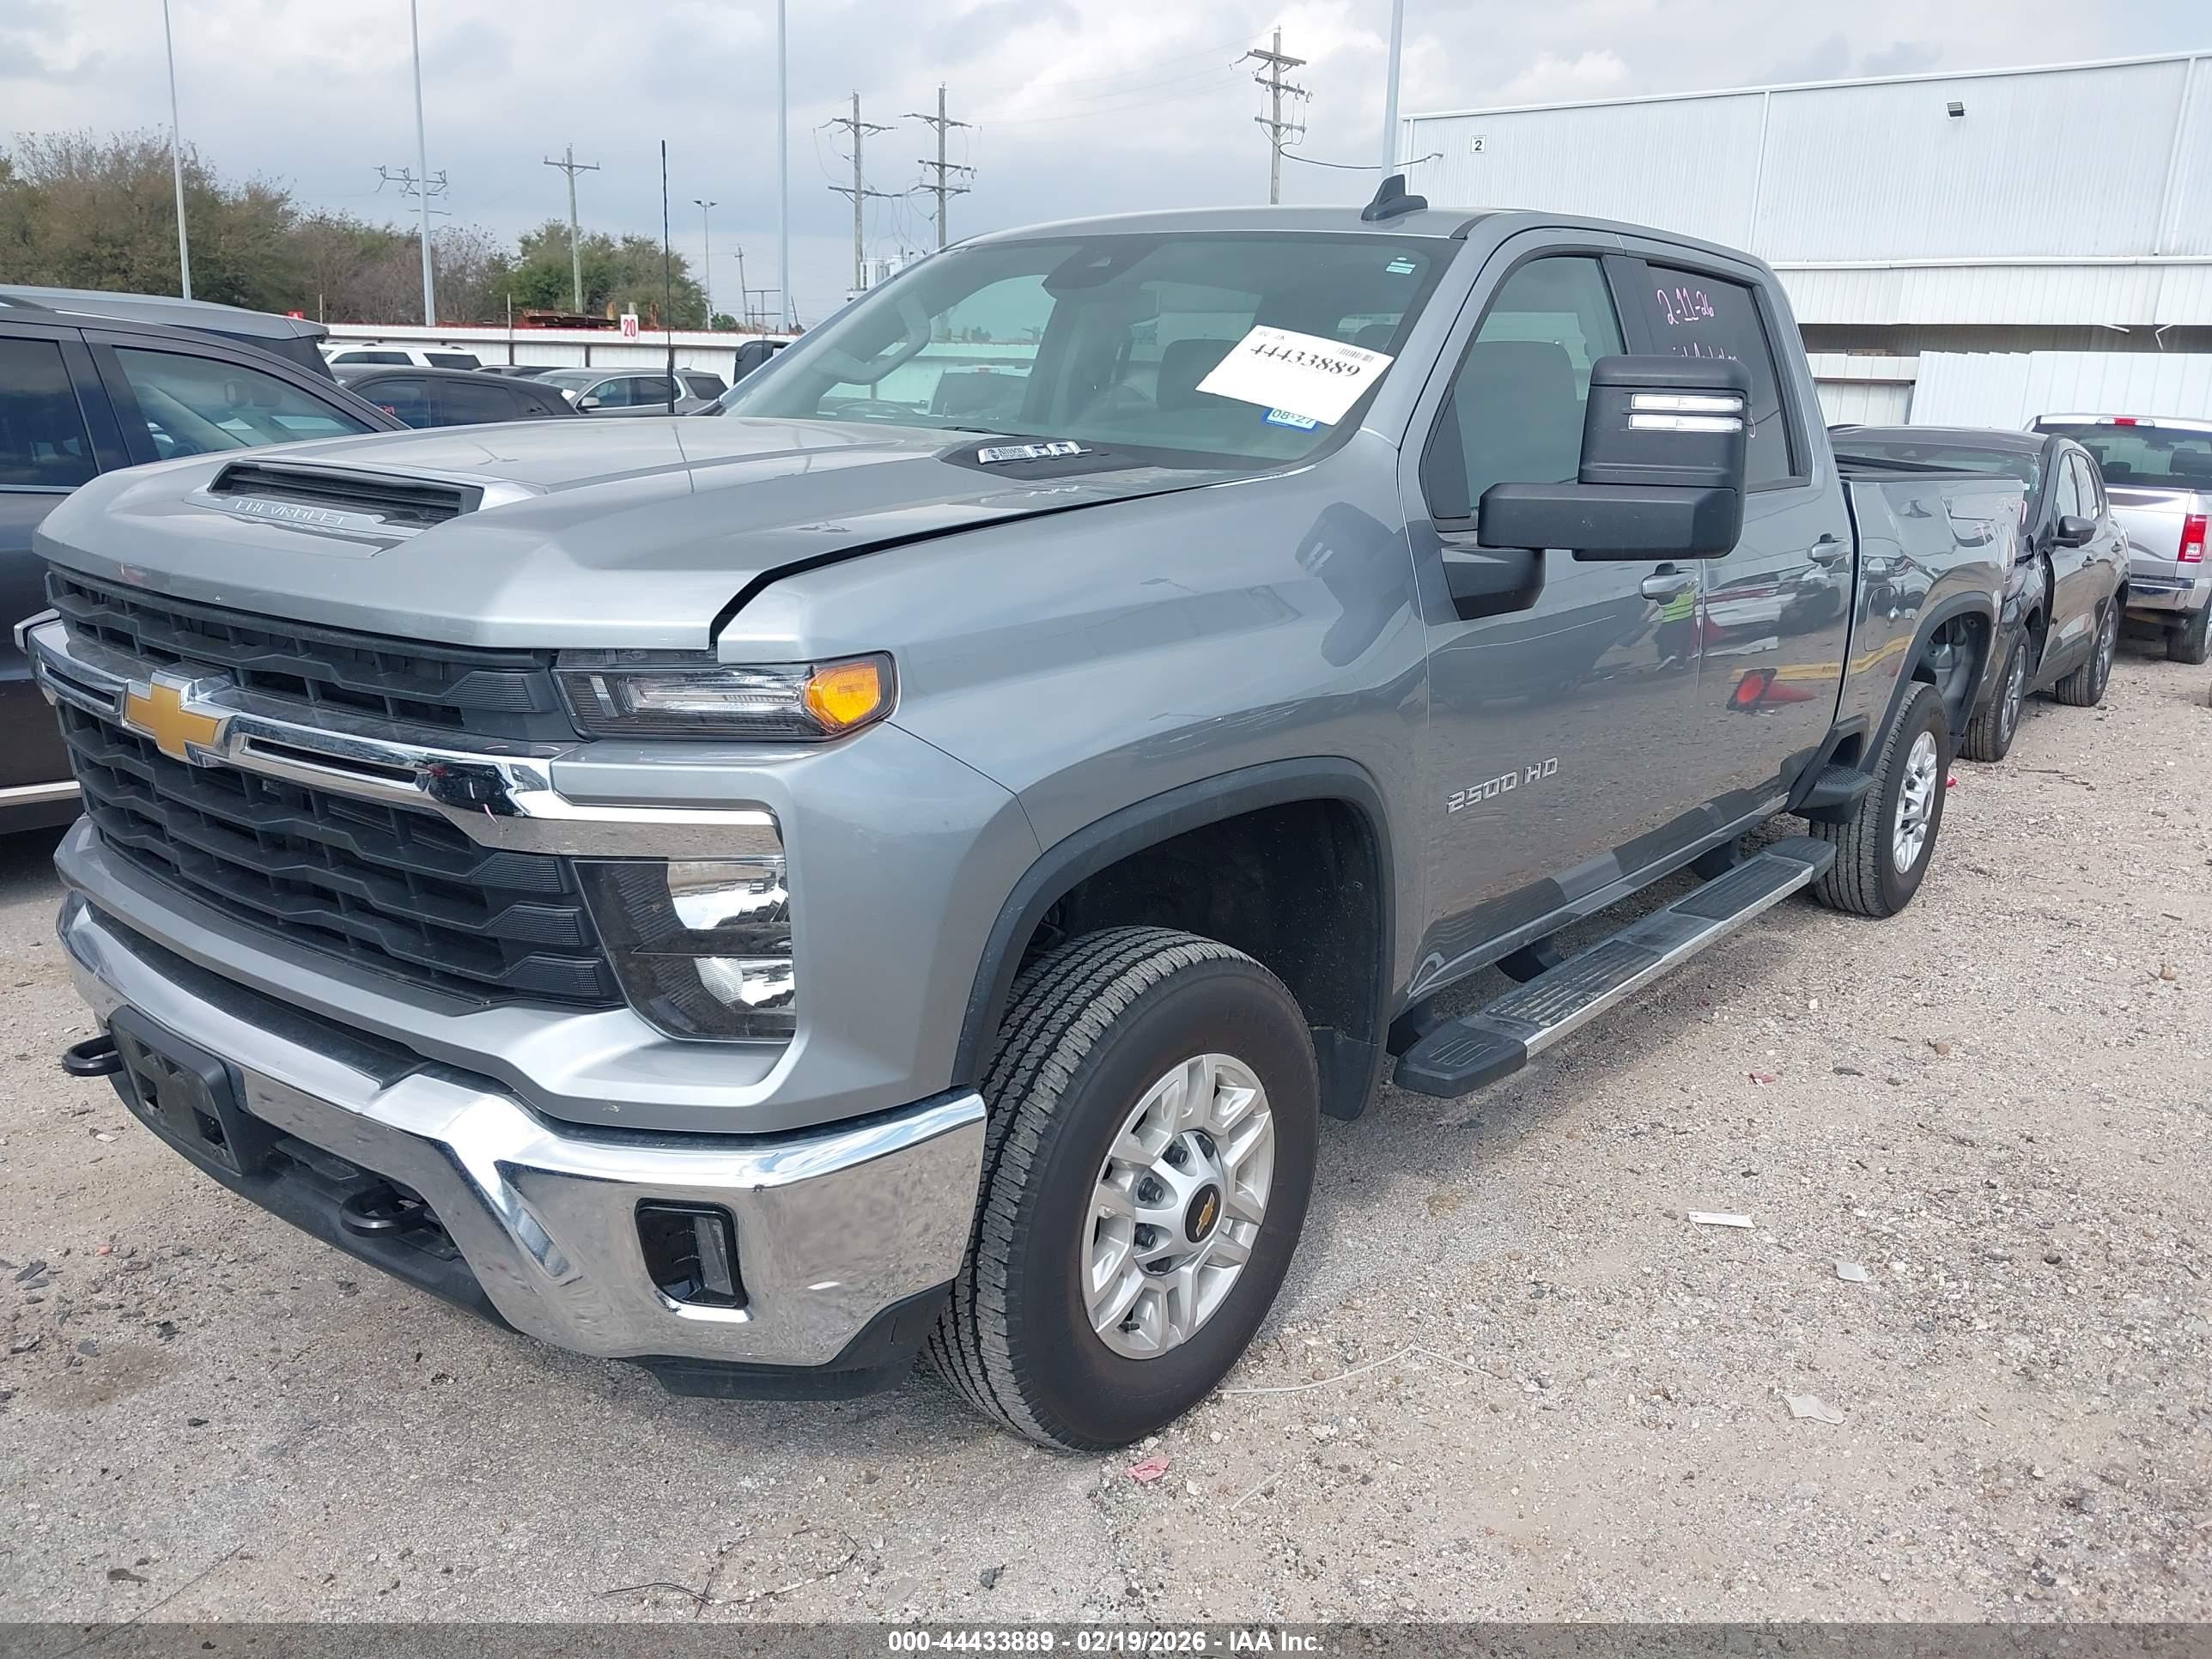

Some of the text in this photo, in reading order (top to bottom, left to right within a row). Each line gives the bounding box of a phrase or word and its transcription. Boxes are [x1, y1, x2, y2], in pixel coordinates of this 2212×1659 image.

[1474, 139, 1482, 151] 2
[623, 319, 636, 337] 20
[1249, 343, 1361, 378] 44433889
[234, 500, 351, 526] CHEVROLET
[1447, 757, 1559, 814] 2500 HD
